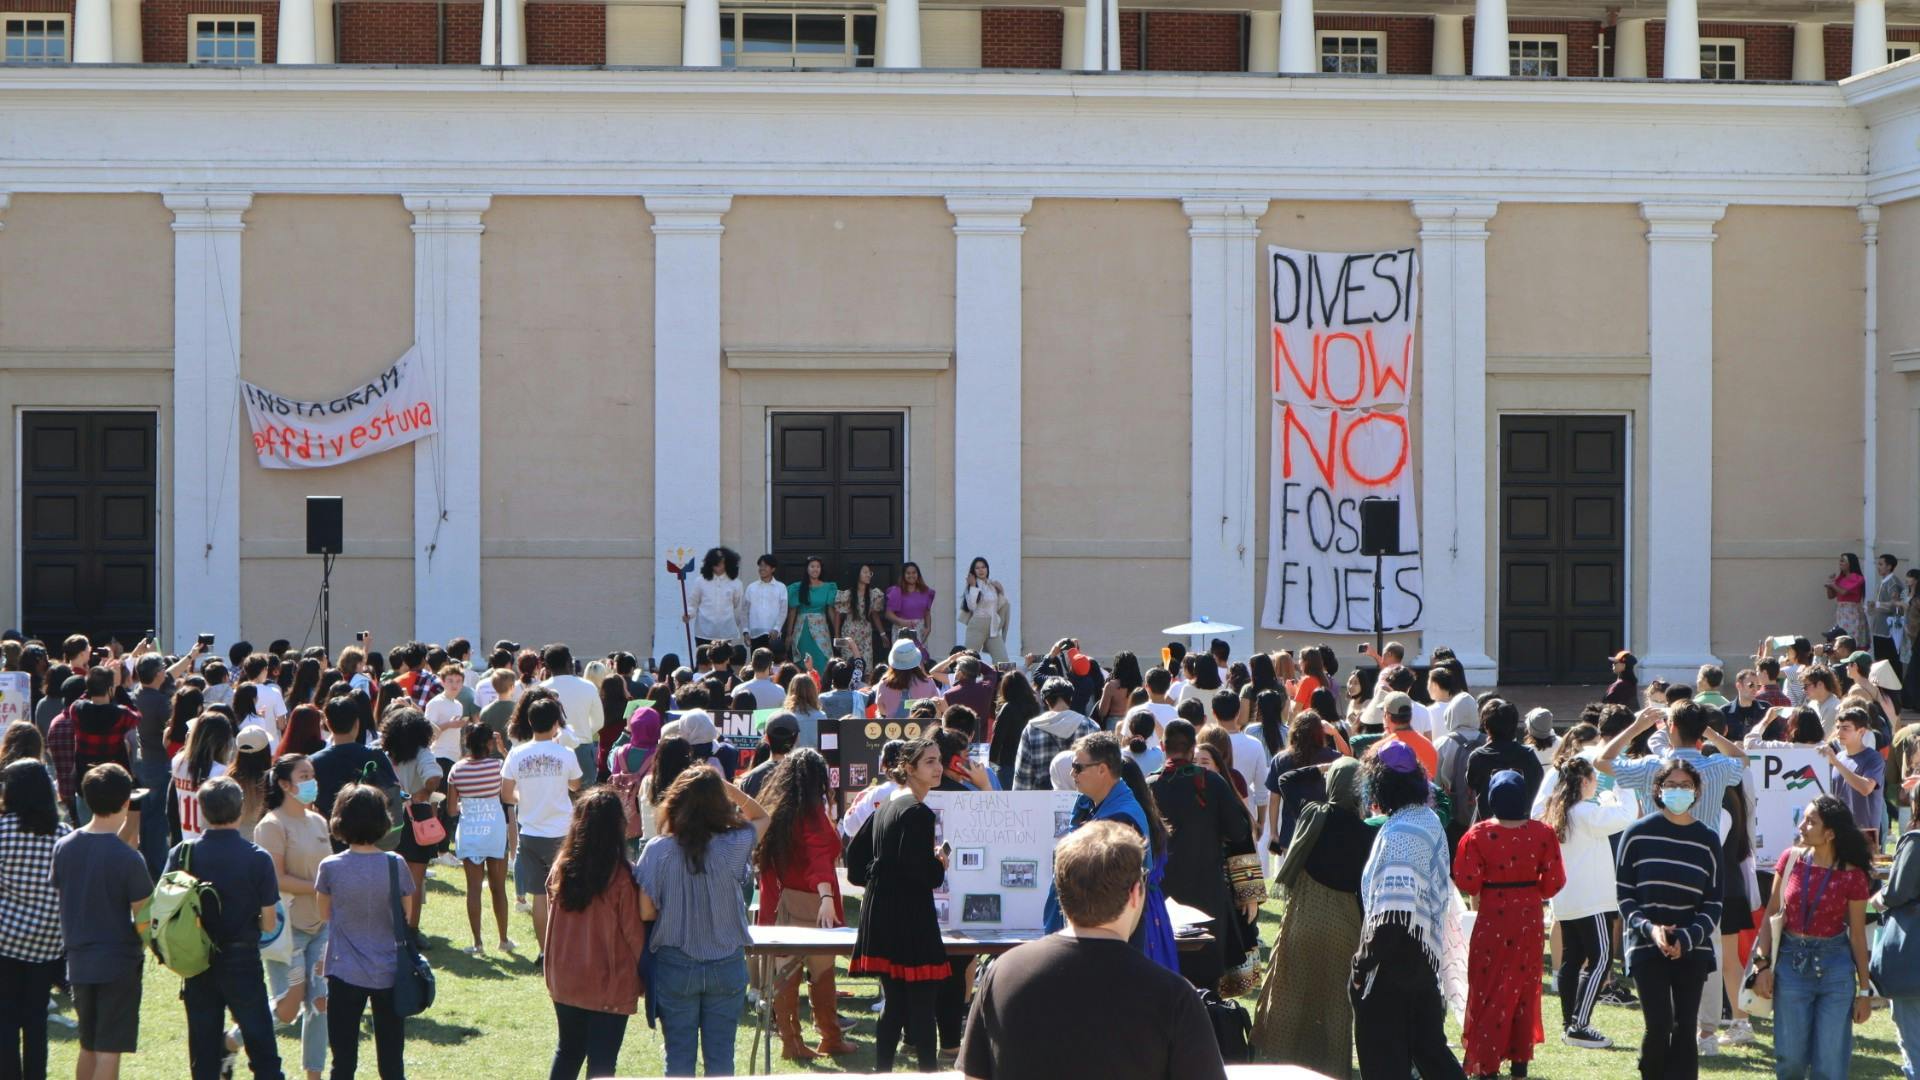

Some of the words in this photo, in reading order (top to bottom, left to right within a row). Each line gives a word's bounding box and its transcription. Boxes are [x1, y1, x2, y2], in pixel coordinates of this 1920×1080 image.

[1273, 247, 1415, 330] DIVEST
[1273, 326, 1412, 406] NOW
[253, 402, 433, 459] @ffdivestuva
[1282, 403, 1410, 489] NO
[1281, 482, 1420, 557] FOS
[1279, 561, 1423, 632] FUELS
[953, 795, 1010, 811] AFGHAN
[953, 829, 1037, 845] ASSOCIATION
[968, 809, 1034, 828] STUDENT
